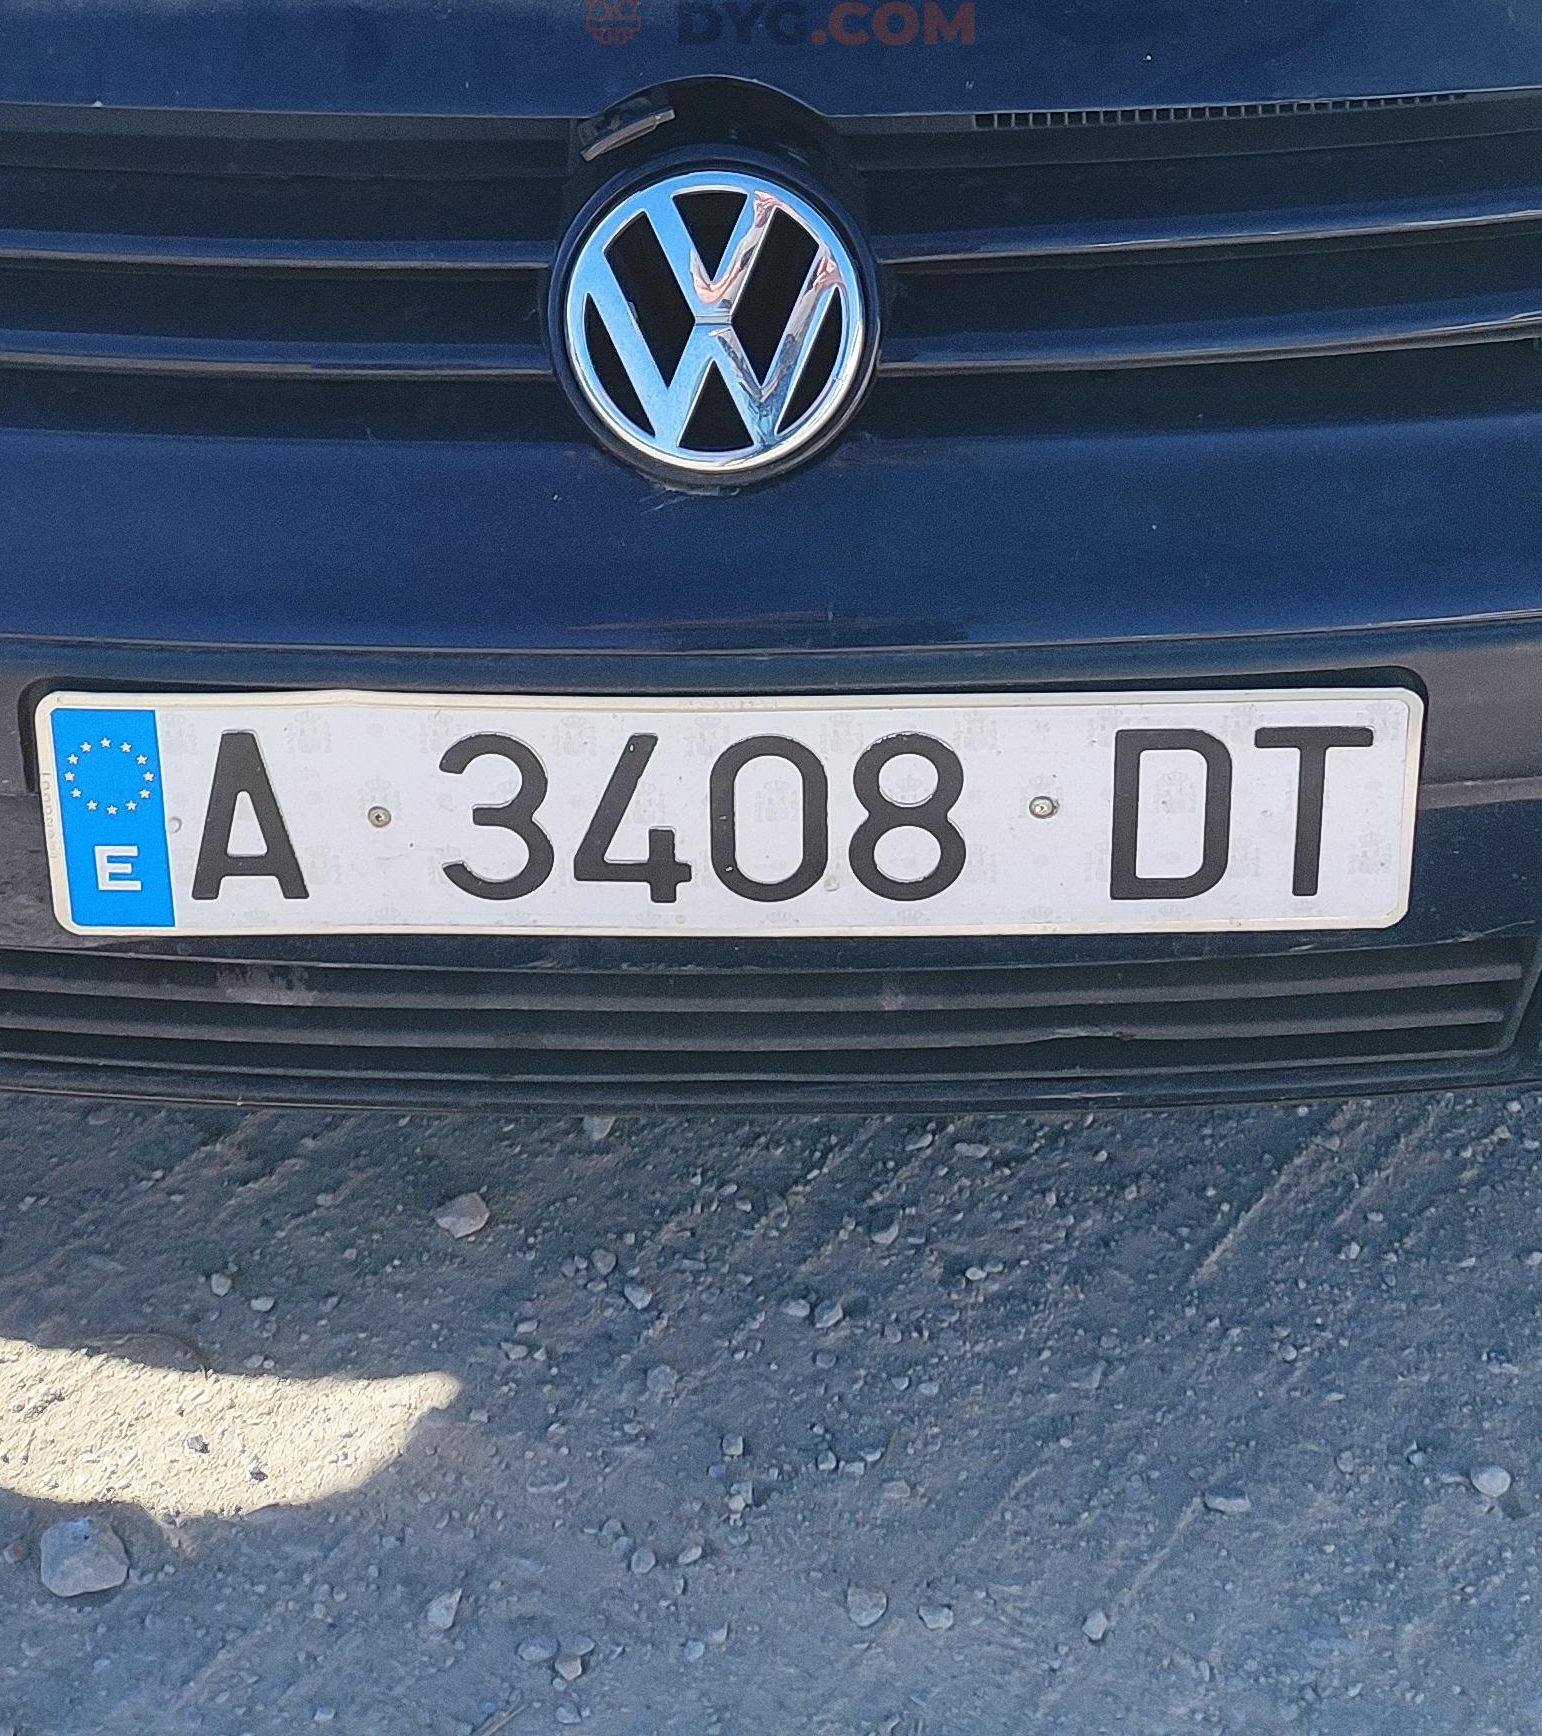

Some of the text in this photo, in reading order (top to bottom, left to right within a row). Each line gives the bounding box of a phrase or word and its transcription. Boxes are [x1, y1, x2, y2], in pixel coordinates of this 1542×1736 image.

[94, 845, 142, 891] E
[191, 730, 310, 901] A
[439, 732, 967, 903] 3408
[1109, 725, 1374, 901] DT
